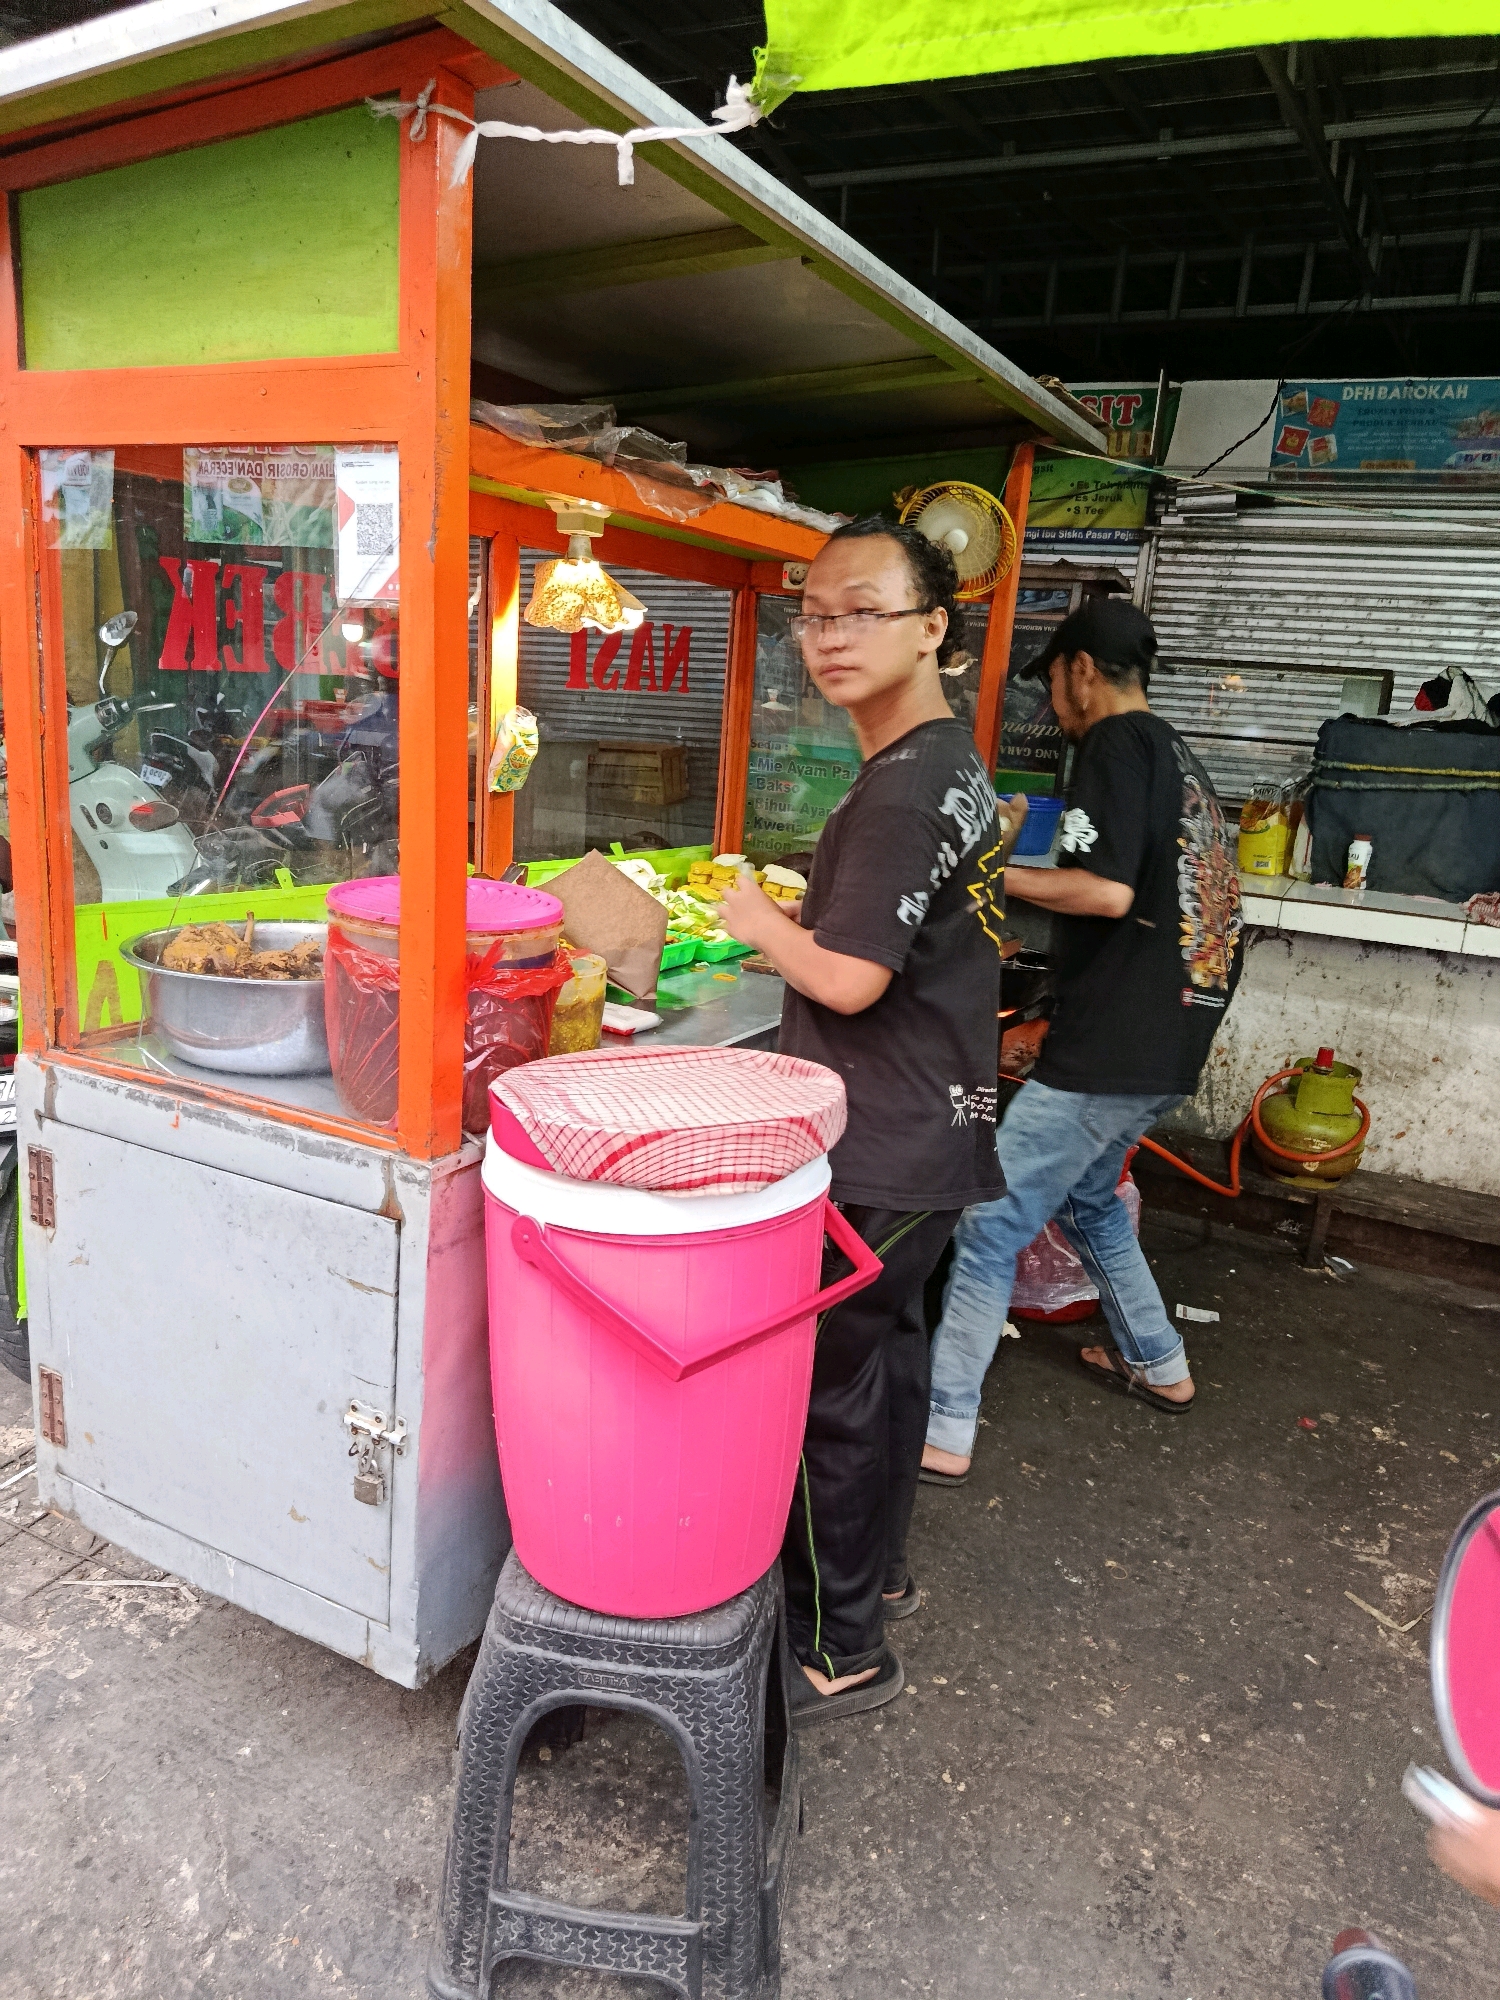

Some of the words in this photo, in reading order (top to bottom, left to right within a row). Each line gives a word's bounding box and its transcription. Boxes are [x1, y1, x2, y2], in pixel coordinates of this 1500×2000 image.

[1376, 384, 1469, 400] BAROKAH
[1033, 464, 1054, 475] gsit
[1091, 493, 1123, 502] Jeruk
[1084, 506, 1105, 515] Tee
[1085, 530, 1114, 540] Pasar
[1035, 748, 1059, 760] ANG
[757, 757, 783, 772] Mie
[786, 760, 828, 779] Ayam
[755, 776, 800, 794] Bakso
